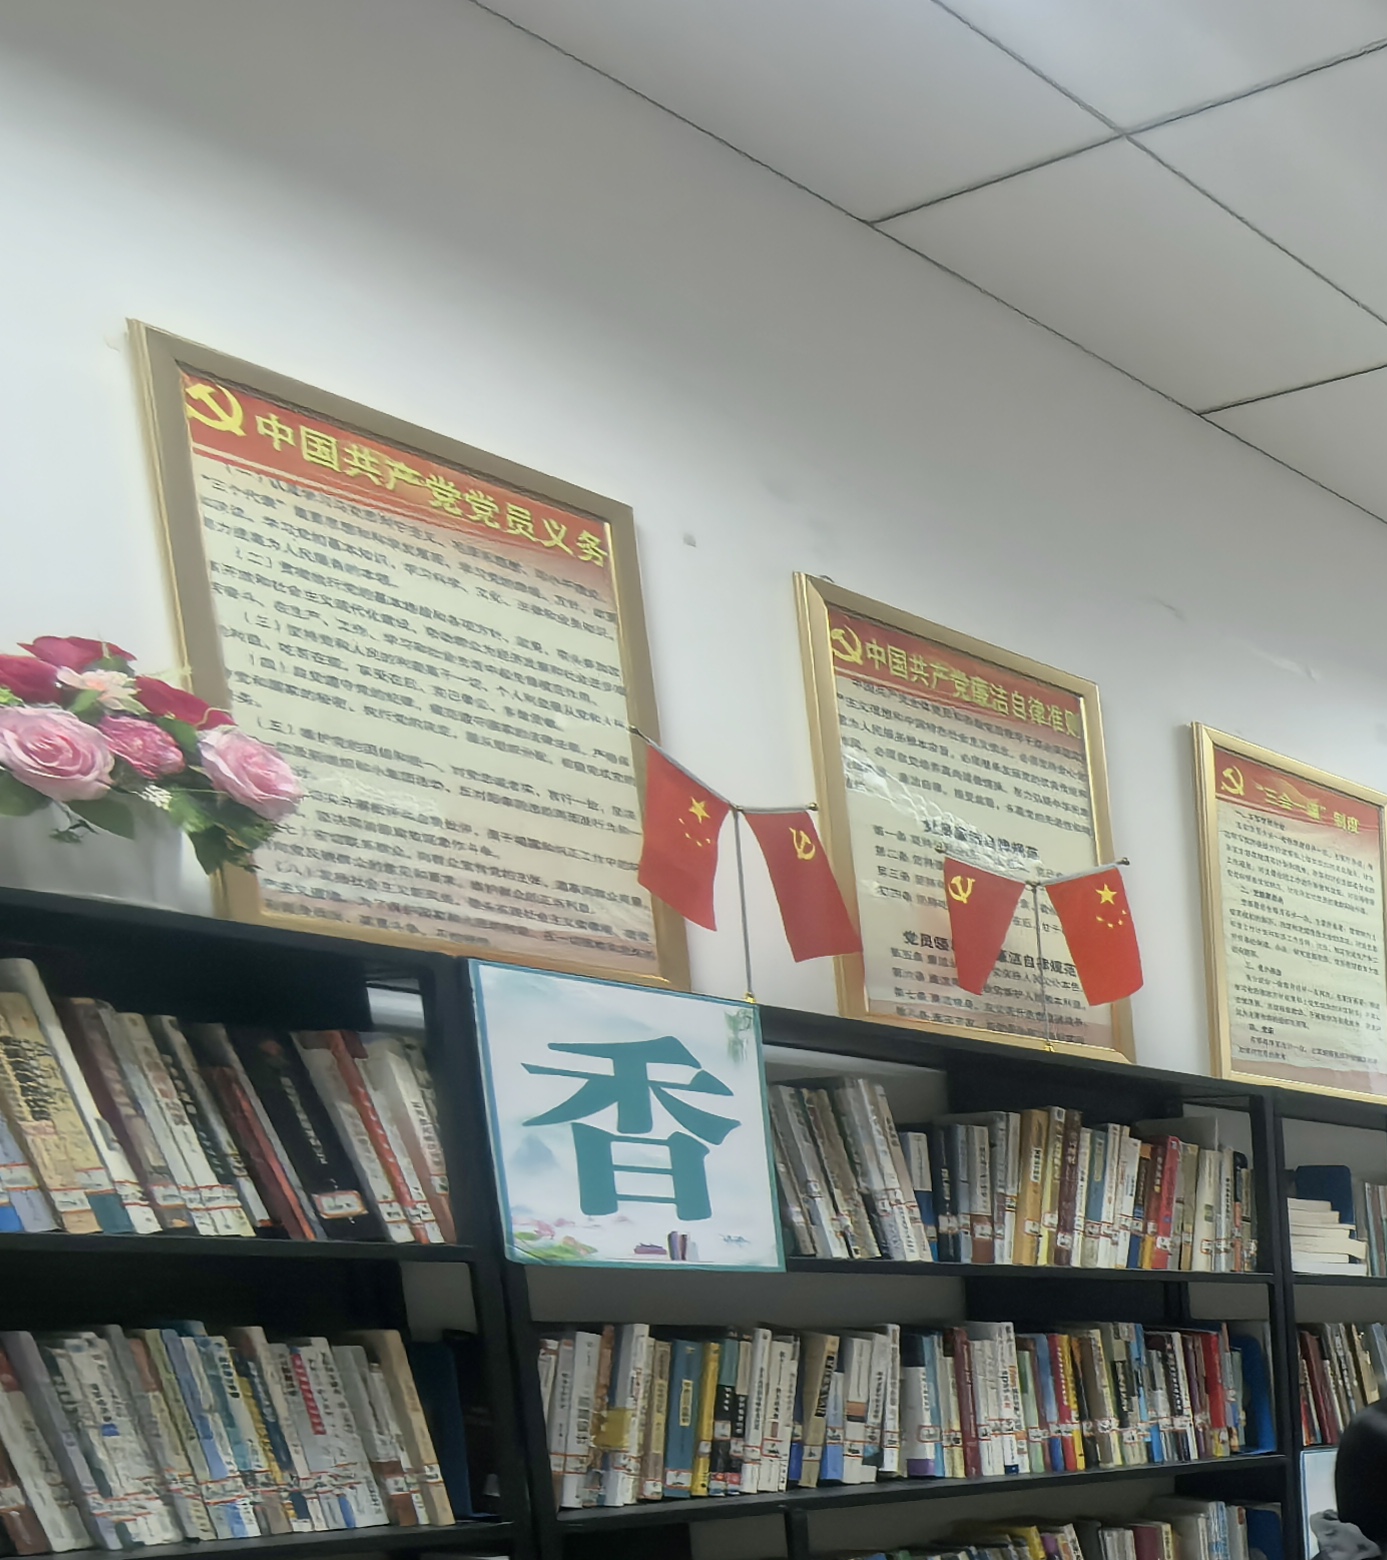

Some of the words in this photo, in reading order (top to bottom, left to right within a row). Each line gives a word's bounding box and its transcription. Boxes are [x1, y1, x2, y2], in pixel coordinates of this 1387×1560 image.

[256, 409, 608, 568] 中国共产党党员义务
[520, 1035, 742, 1221] 香
